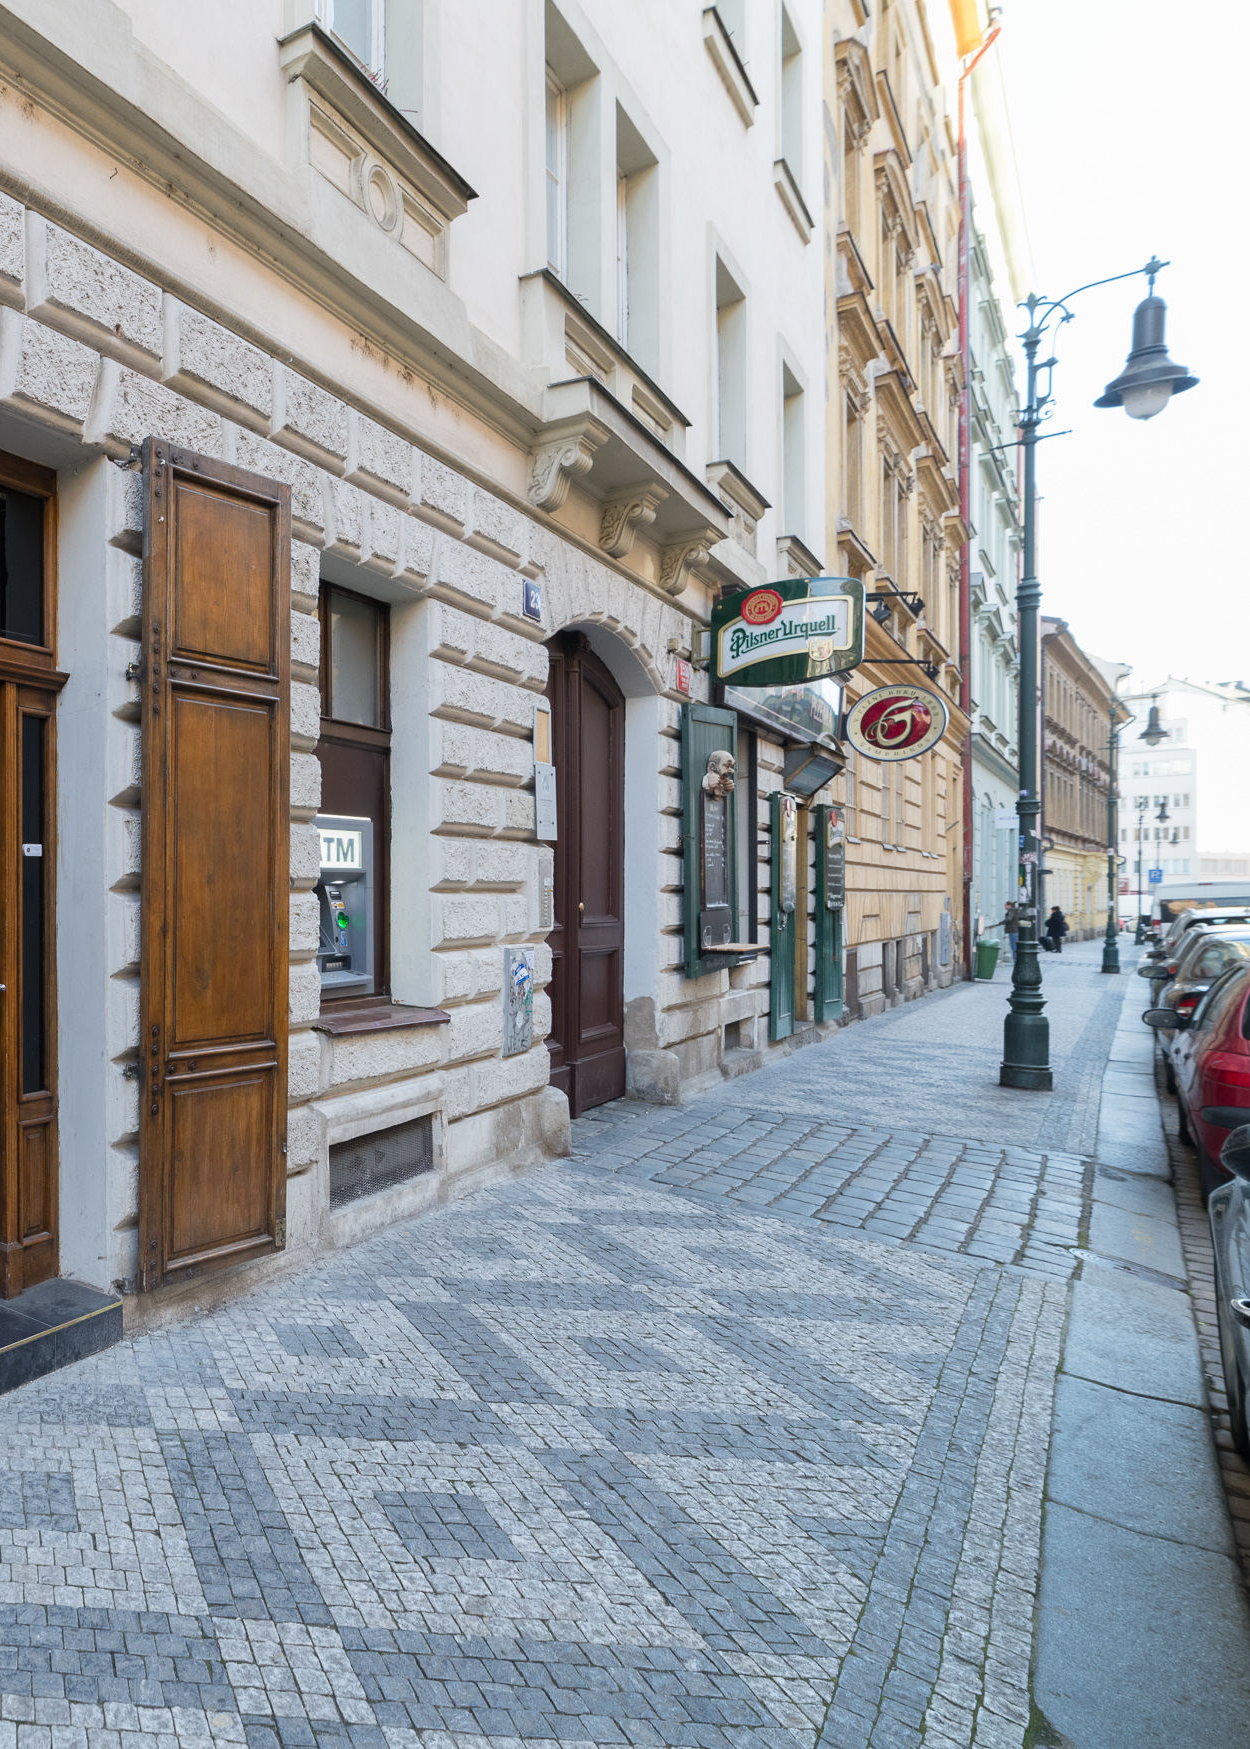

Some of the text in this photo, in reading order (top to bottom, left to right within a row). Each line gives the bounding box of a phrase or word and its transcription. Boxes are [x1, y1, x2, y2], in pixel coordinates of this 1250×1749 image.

[530, 590, 539, 610] 23
[730, 615, 836, 660] Pilsner Urquell
[859, 738, 930, 757] GAMBRINUS
[320, 836, 354, 863] TM
